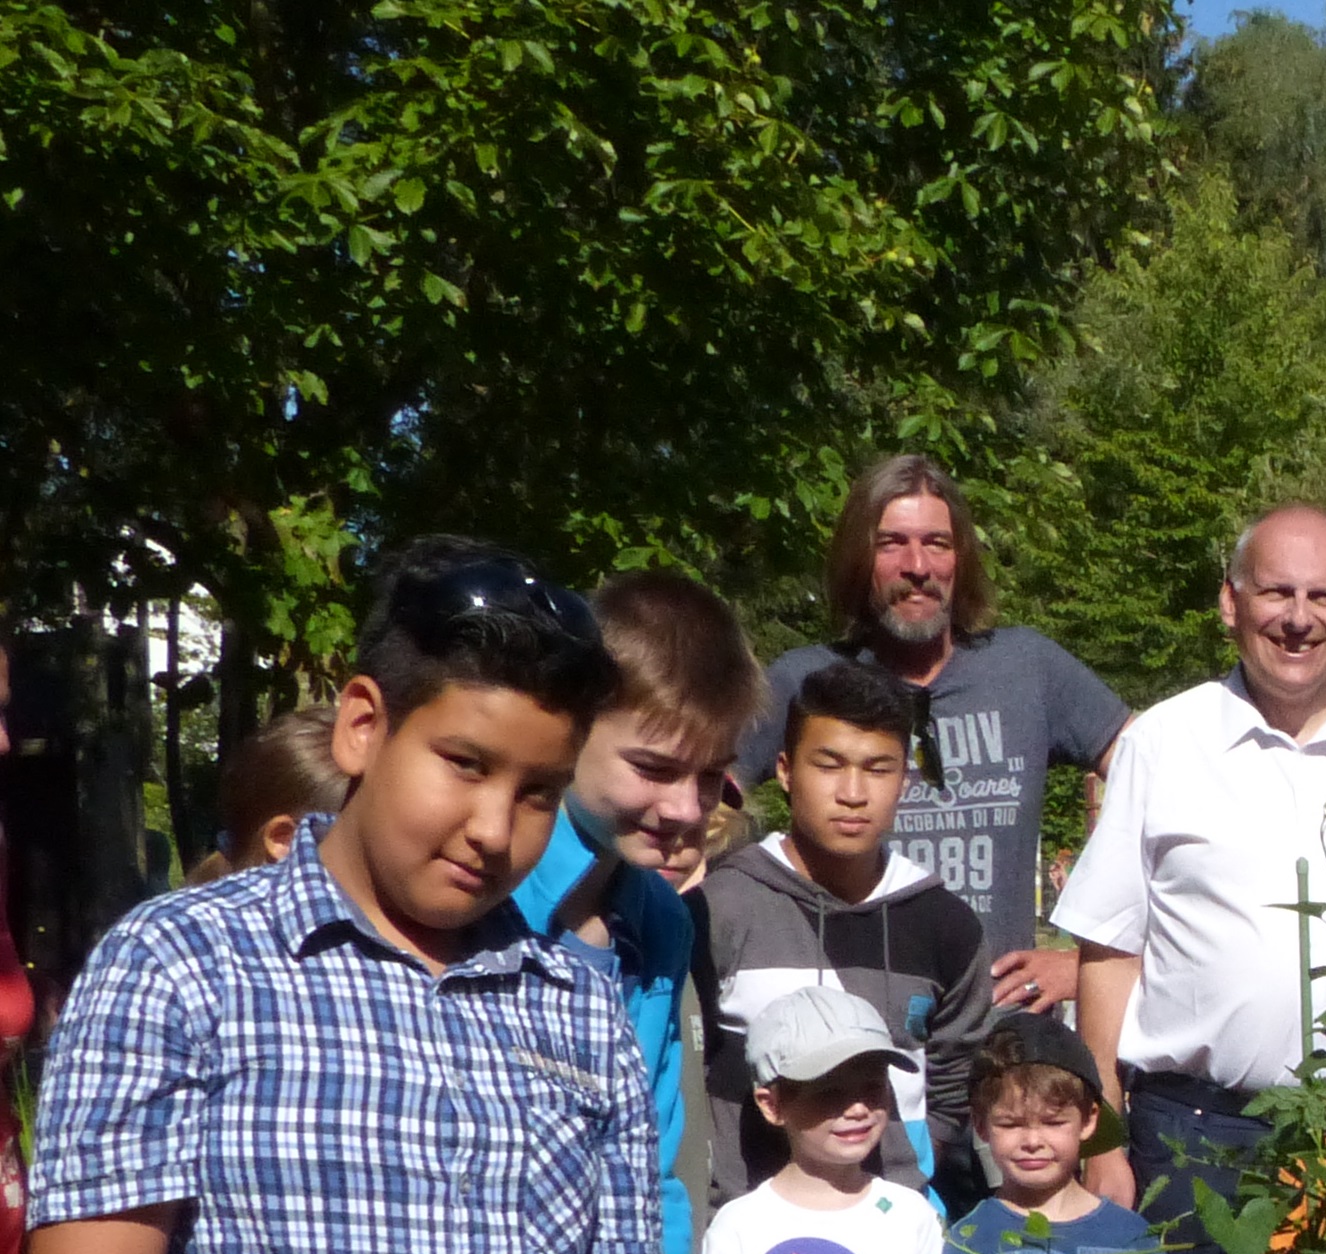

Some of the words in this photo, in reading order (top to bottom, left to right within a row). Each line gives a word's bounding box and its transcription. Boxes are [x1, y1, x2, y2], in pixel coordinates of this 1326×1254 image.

[972, 808, 988, 828] DI
[993, 807, 1016, 826] RIO
[888, 835, 993, 891] 989
